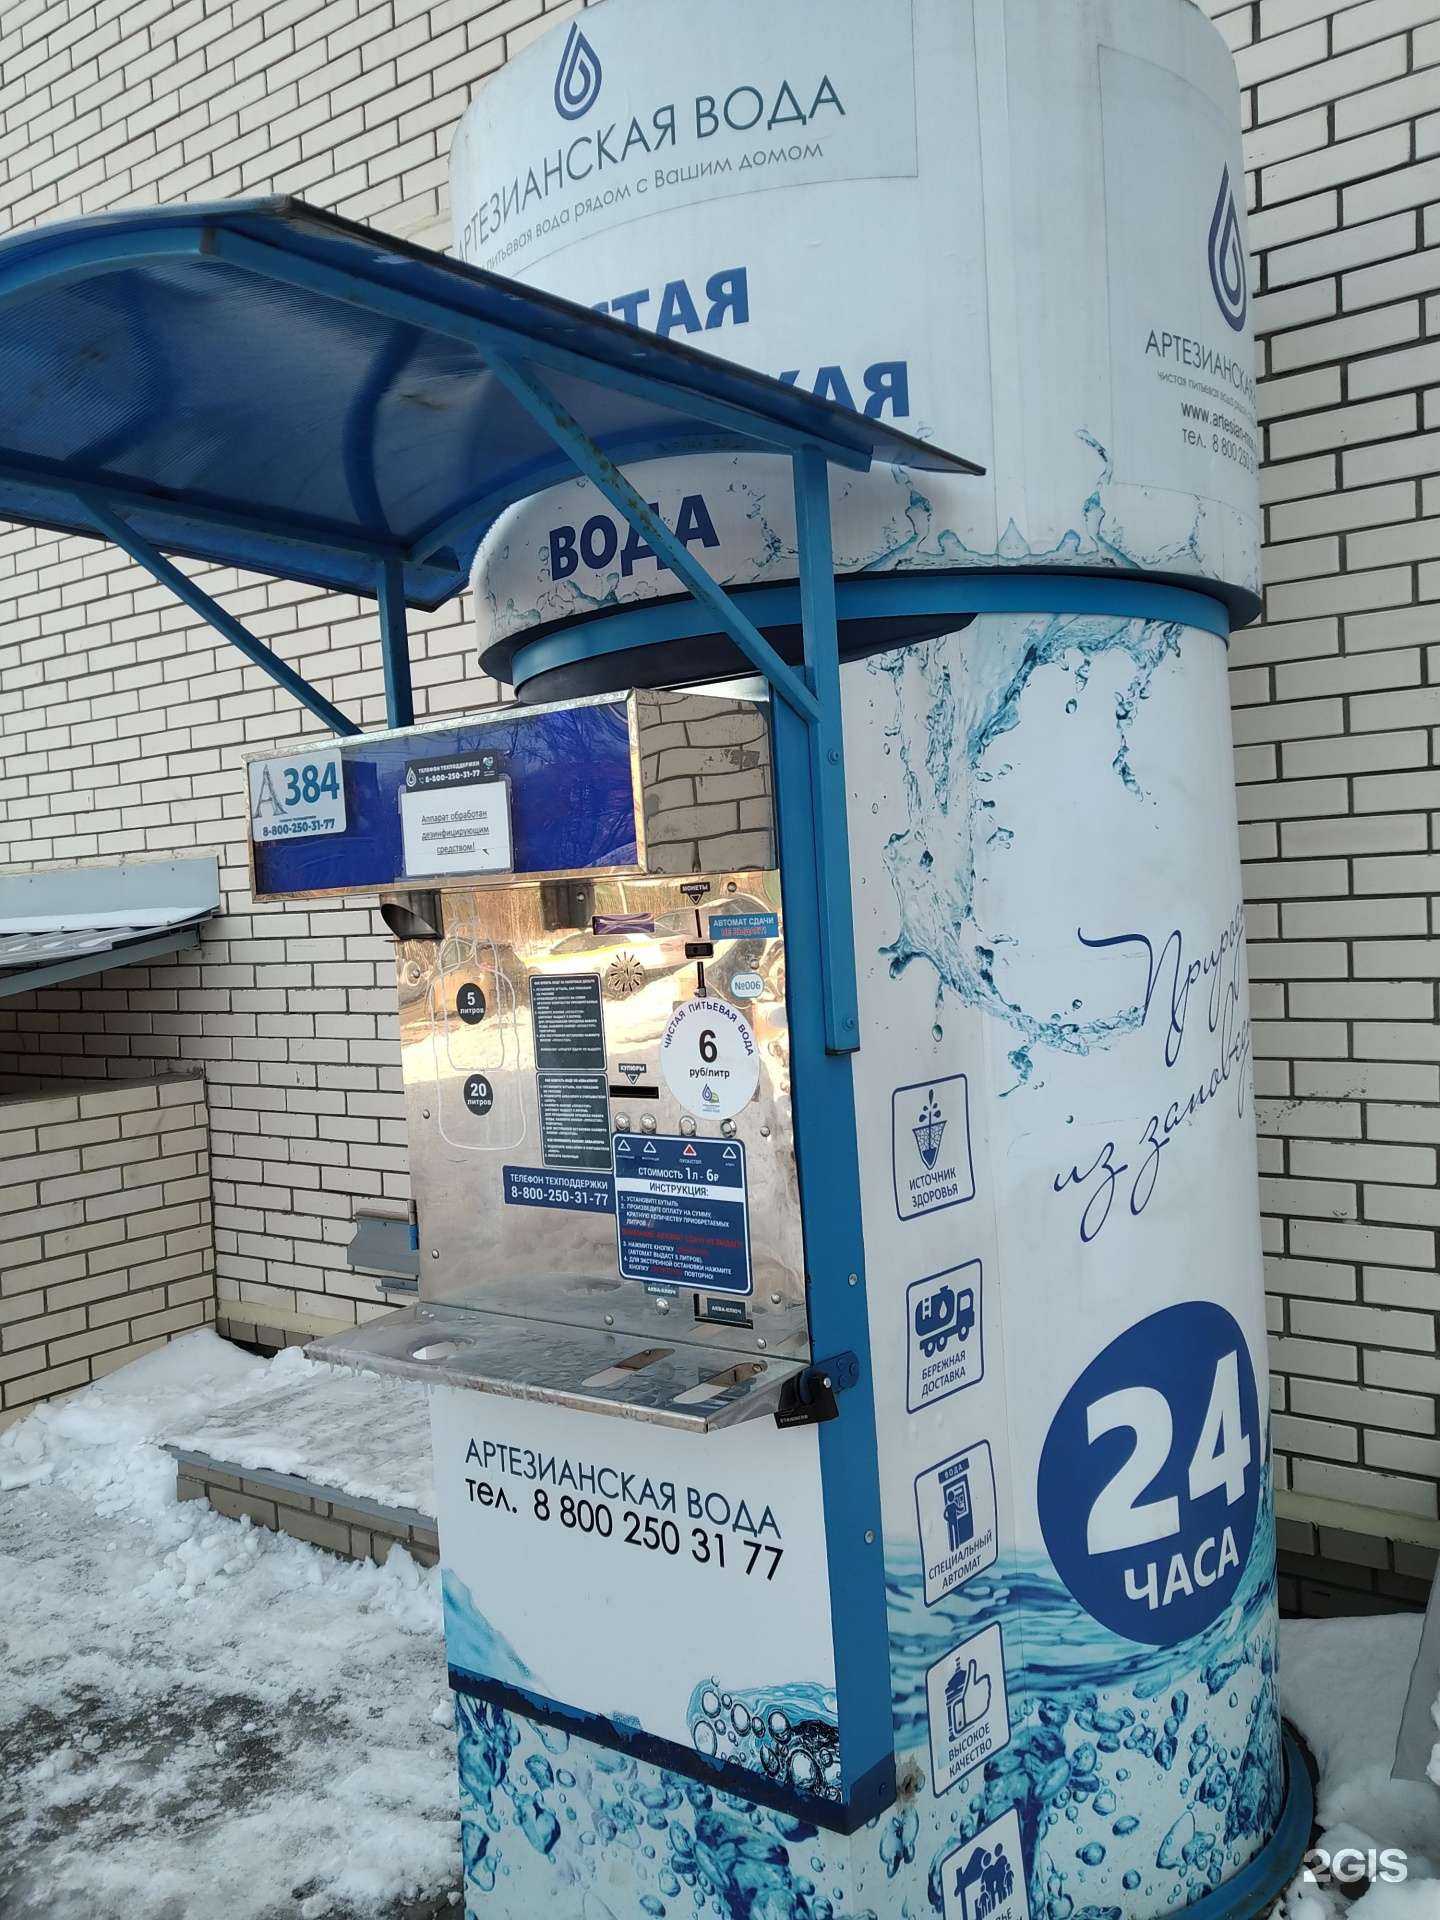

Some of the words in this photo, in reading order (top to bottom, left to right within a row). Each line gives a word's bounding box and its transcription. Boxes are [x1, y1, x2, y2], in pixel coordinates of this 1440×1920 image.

[459, 104, 677, 264] АРТЕЗИАНСКАЯ
[696, 74, 846, 140] ВОДА
[535, 208, 570, 238] вода
[574, 185, 632, 223] рядом
[636, 178, 648, 194] с
[654, 157, 733, 188] Вашим
[738, 140, 824, 170] домом
[1182, 427, 1207, 449] тел.
[1213, 433, 1219, 453] 8
[1222, 437, 1237, 461] 800
[549, 494, 720, 581] ВОДА
[283, 762, 340, 806] 384
[262, 818, 335, 837] 8-800-250-31-77
[681, 884, 708, 892] МОНЕТЫ
[713, 918, 747, 927] АВТОМАТ
[748, 917, 774, 925] СДАЧИ
[467, 992, 475, 1005] 5
[734, 980, 761, 991] №006
[1078, 905, 1244, 1067] Природ
[664, 1010, 686, 1049] ЧИСТАЯ
[688, 1001, 737, 1023] ПИТЬЕВАЯ
[738, 1023, 754, 1056] ВОДА
[699, 1029, 718, 1063] 6
[620, 1064, 645, 1072] КУПЮРЫ
[689, 1067, 730, 1080] руб/литр
[470, 1083, 487, 1096] 20
[510, 1174, 544, 1184] ТЕЛЕФОН
[545, 1177, 608, 1189] ТЕХПОДДЕРЖКИ
[638, 1167, 683, 1180] СТОИМОСТЬ
[649, 1182, 709, 1196] ИНСТРУКЦИЯ:
[909, 1167, 957, 1191] ИСТОЧНИК
[511, 1186, 608, 1206] 8-800-250-31-77
[912, 1183, 959, 1208] ЗДОРОВЬЯ
[1054, 1142, 1128, 1243] из
[922, 1350, 966, 1380] БЕРЕЖНАЯ
[921, 1366, 966, 1399] ДОСТАВКА
[1086, 1350, 1251, 1555] 24
[944, 1463, 964, 1479] ВОДА
[465, 1438, 677, 1514] АРТЕЗИАНСКАЯ
[687, 1486, 782, 1539] ВОДА
[465, 1478, 518, 1514] тел.
[533, 1488, 550, 1521] 8
[560, 1495, 613, 1538] 800
[623, 1511, 680, 1555] 250
[691, 1528, 725, 1568] 31
[743, 1539, 784, 1581] 77
[928, 1529, 993, 1580] СПЕЦИАЛЬНЫЙ
[1124, 1526, 1240, 1610] ЧАСА
[942, 1555, 982, 1590] АВТОМАТ
[949, 1722, 991, 1762] ВЫСОКОЕ
[949, 1738, 992, 1777] КАЧЕСТВО
